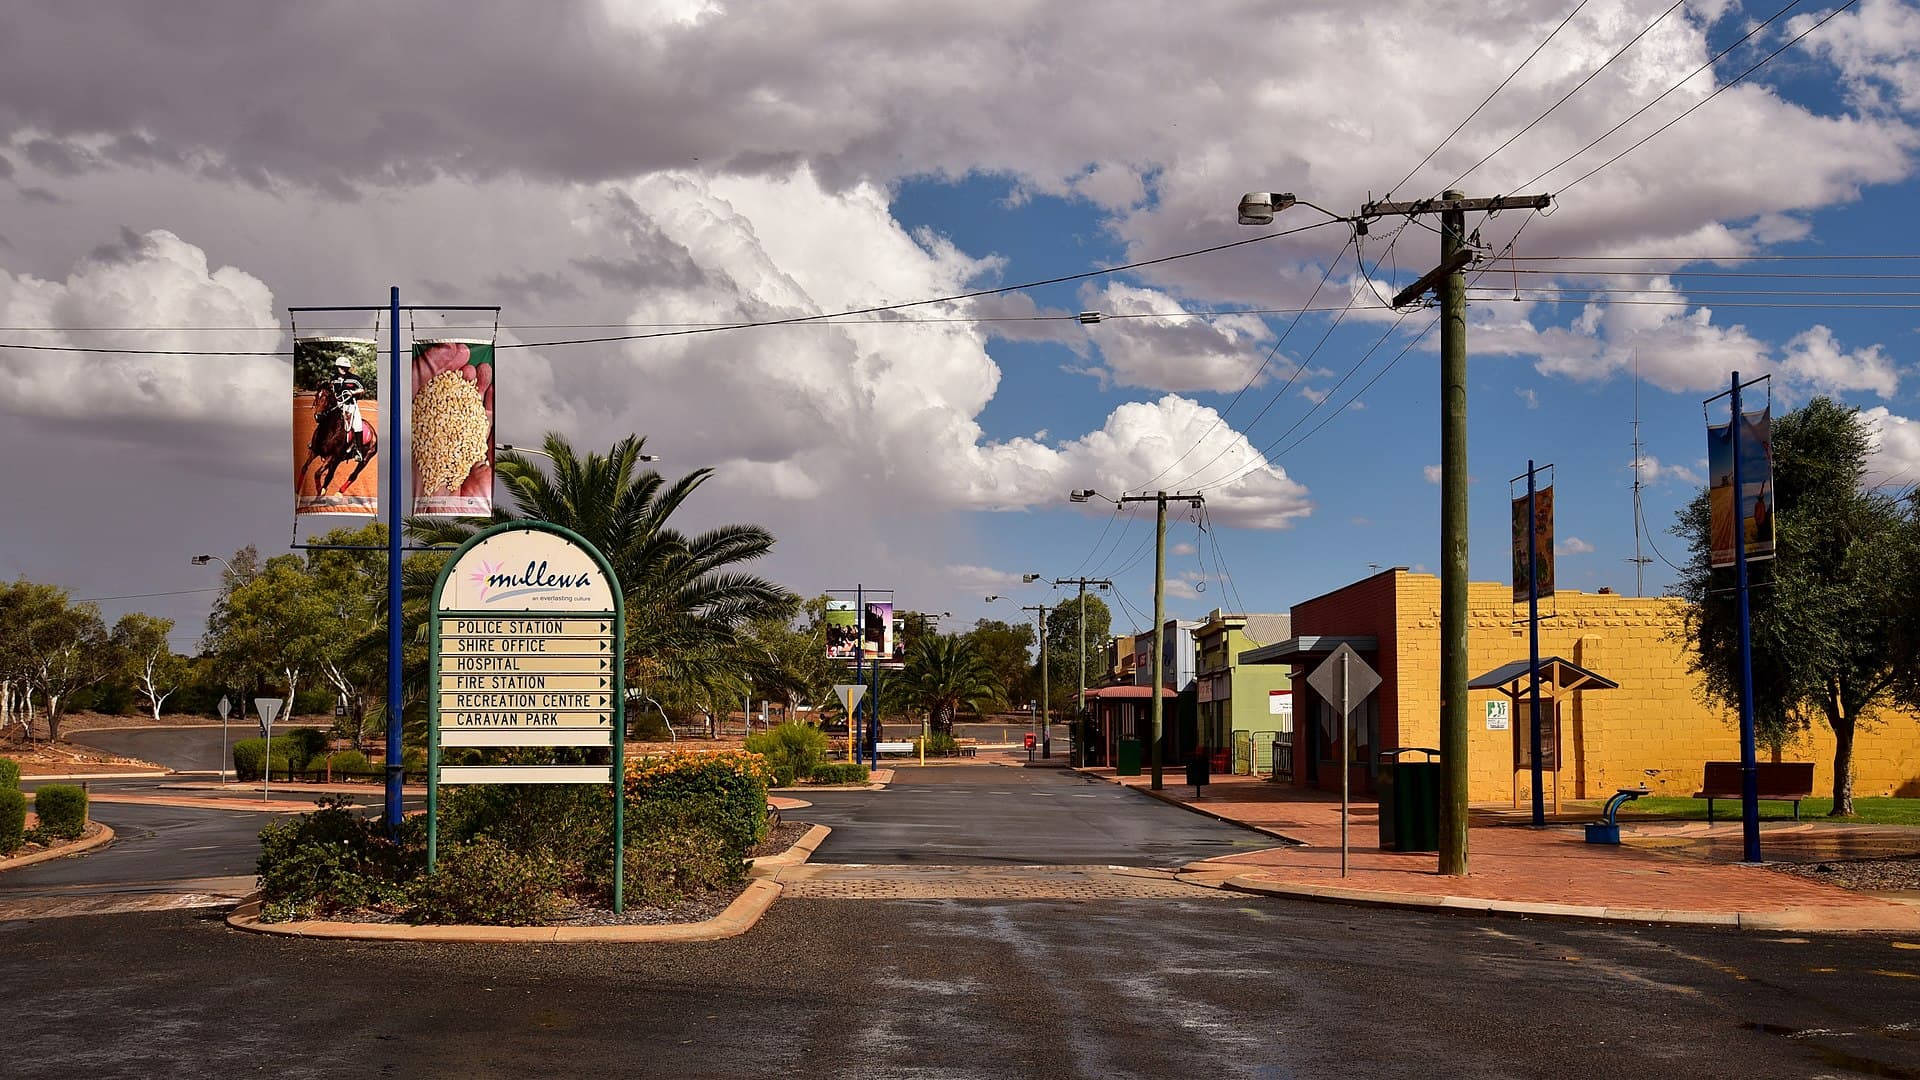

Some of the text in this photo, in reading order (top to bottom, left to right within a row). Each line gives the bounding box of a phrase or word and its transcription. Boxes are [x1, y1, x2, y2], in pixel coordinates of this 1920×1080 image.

[488, 560, 591, 588] mullewa
[540, 594, 573, 602] everlasting
[457, 621, 563, 634] POLICE STATION
[457, 639, 546, 652] SHIRE OFFICE
[457, 657, 521, 671] HOSPITAL
[457, 676, 545, 689] FIRE STATION
[457, 694, 591, 708] RECREATION CENTRE
[456, 713, 558, 726] CARAVAN PARK
